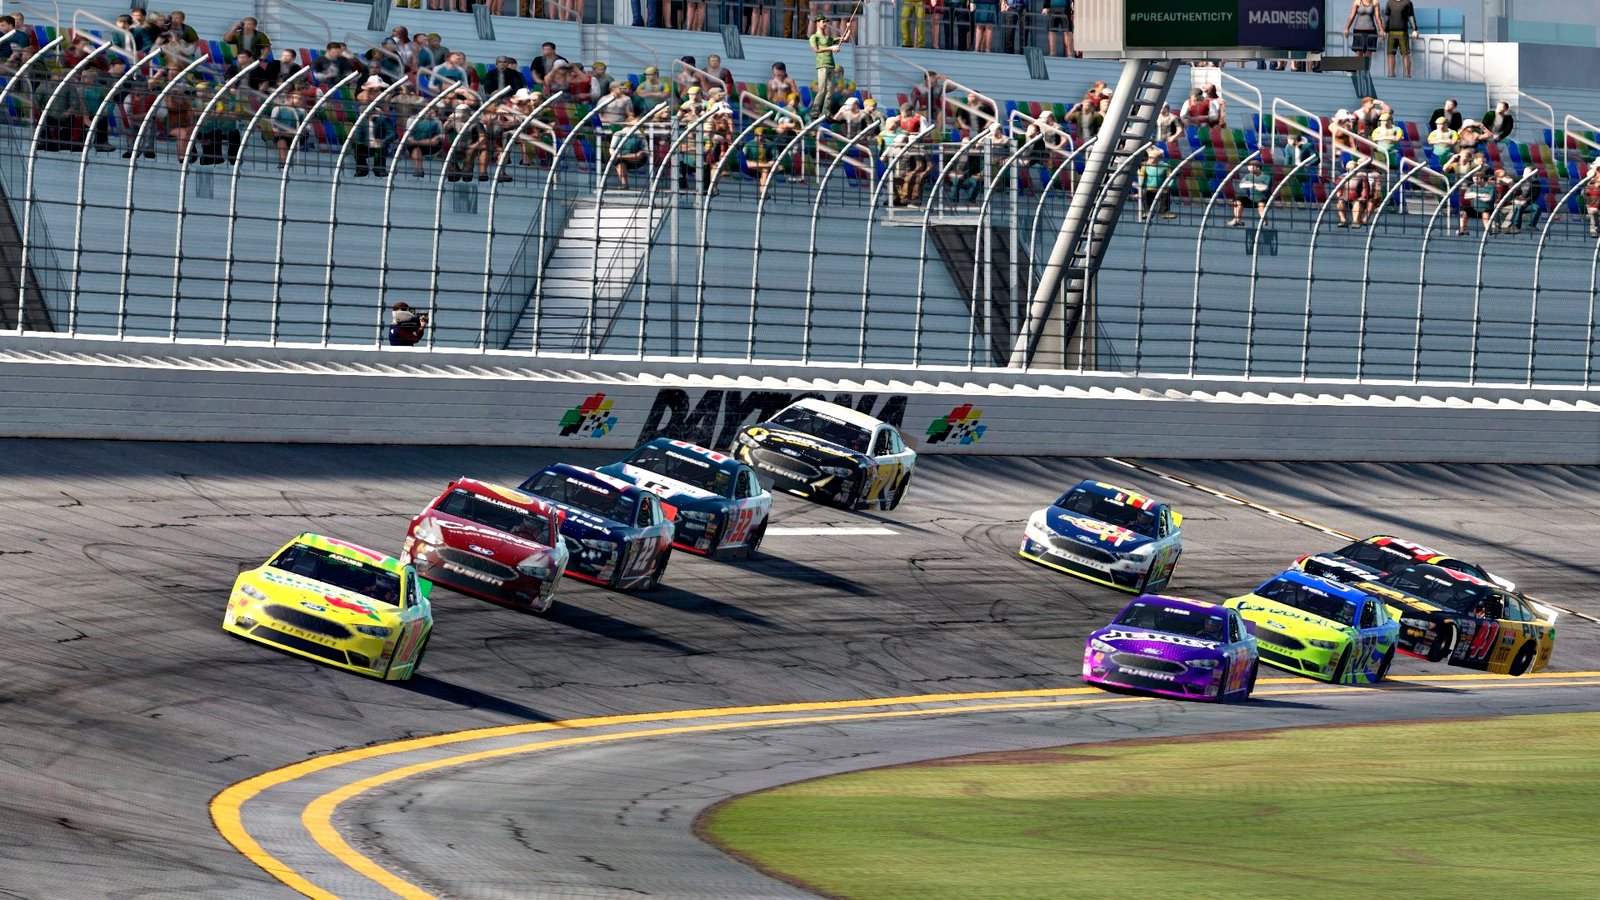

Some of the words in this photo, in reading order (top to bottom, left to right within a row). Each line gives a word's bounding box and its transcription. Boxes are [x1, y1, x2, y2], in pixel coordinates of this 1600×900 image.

[1130, 11, 1233, 22] #PUREAUTHENTICITY
[1249, 10, 1309, 24] MADNESS
[635, 388, 908, 447] DAYTA
[443, 562, 504, 587] FUSION
[1469, 620, 1500, 660] 41
[1118, 667, 1176, 682] FUSION
